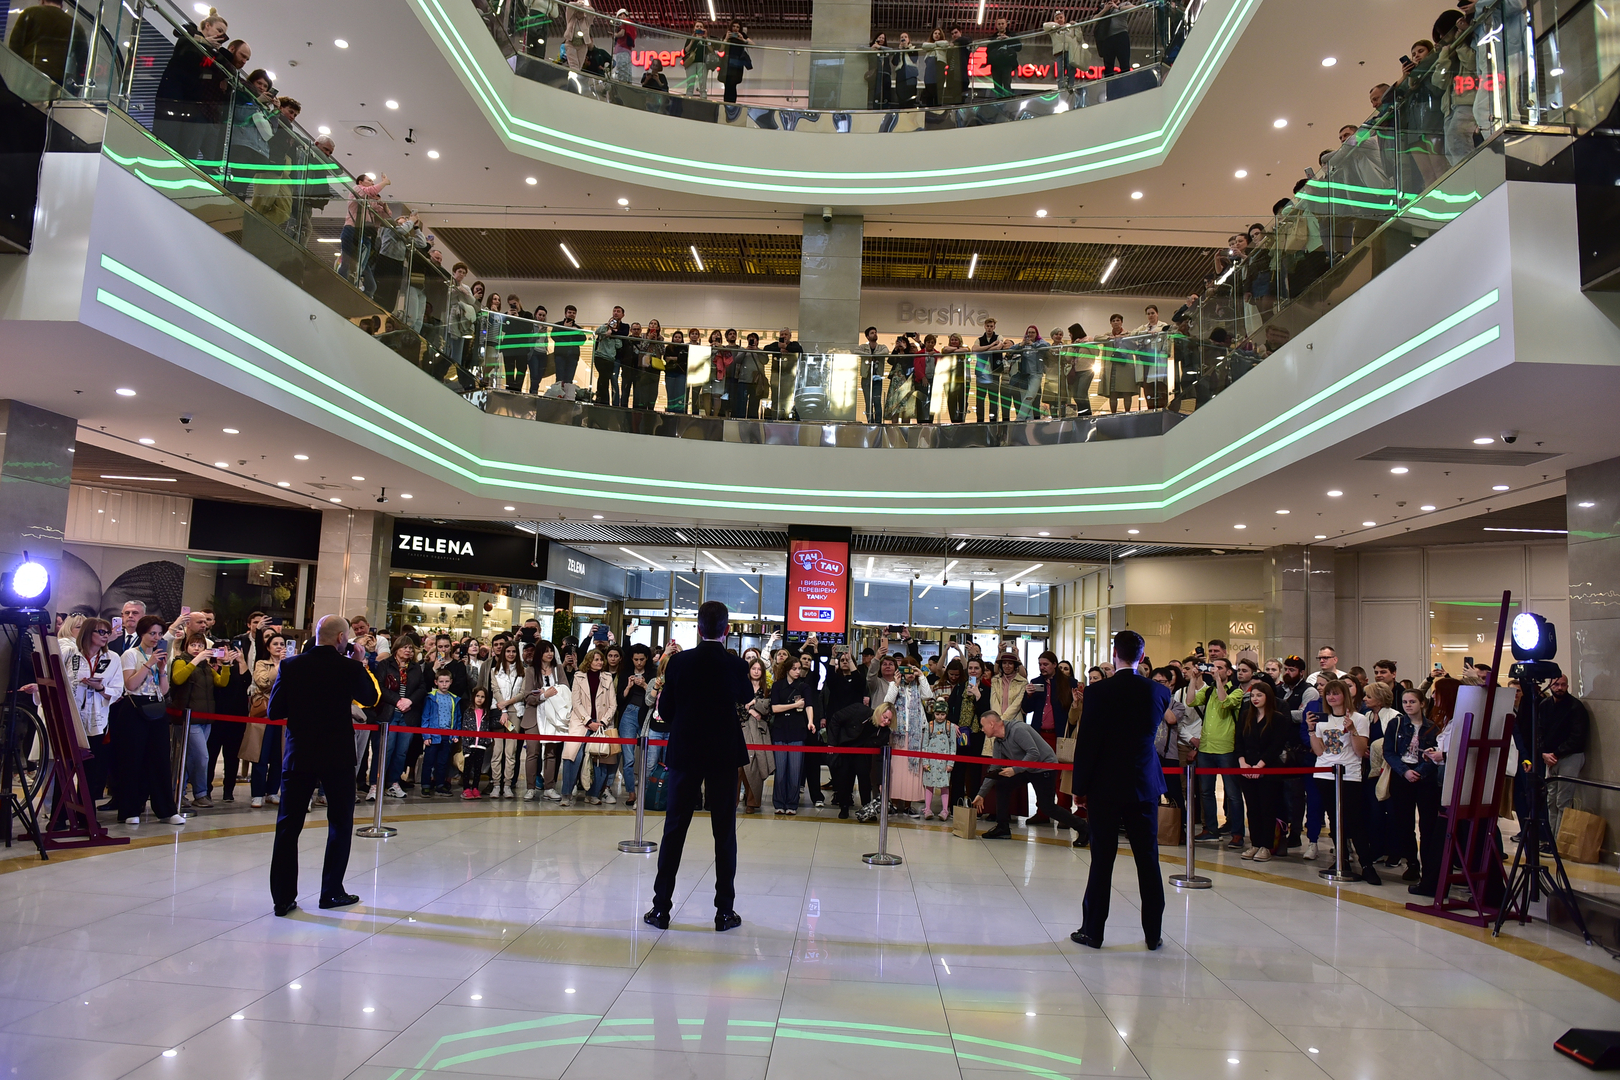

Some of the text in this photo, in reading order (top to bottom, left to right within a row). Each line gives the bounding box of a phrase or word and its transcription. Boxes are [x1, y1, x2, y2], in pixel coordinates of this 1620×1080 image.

[898, 302, 989, 326] Bershka
[399, 534, 474, 556] ZELENA
[799, 553, 818, 561] ТАЧ
[568, 558, 586, 575] ZELENA
[821, 561, 839, 573] ТАЧ
